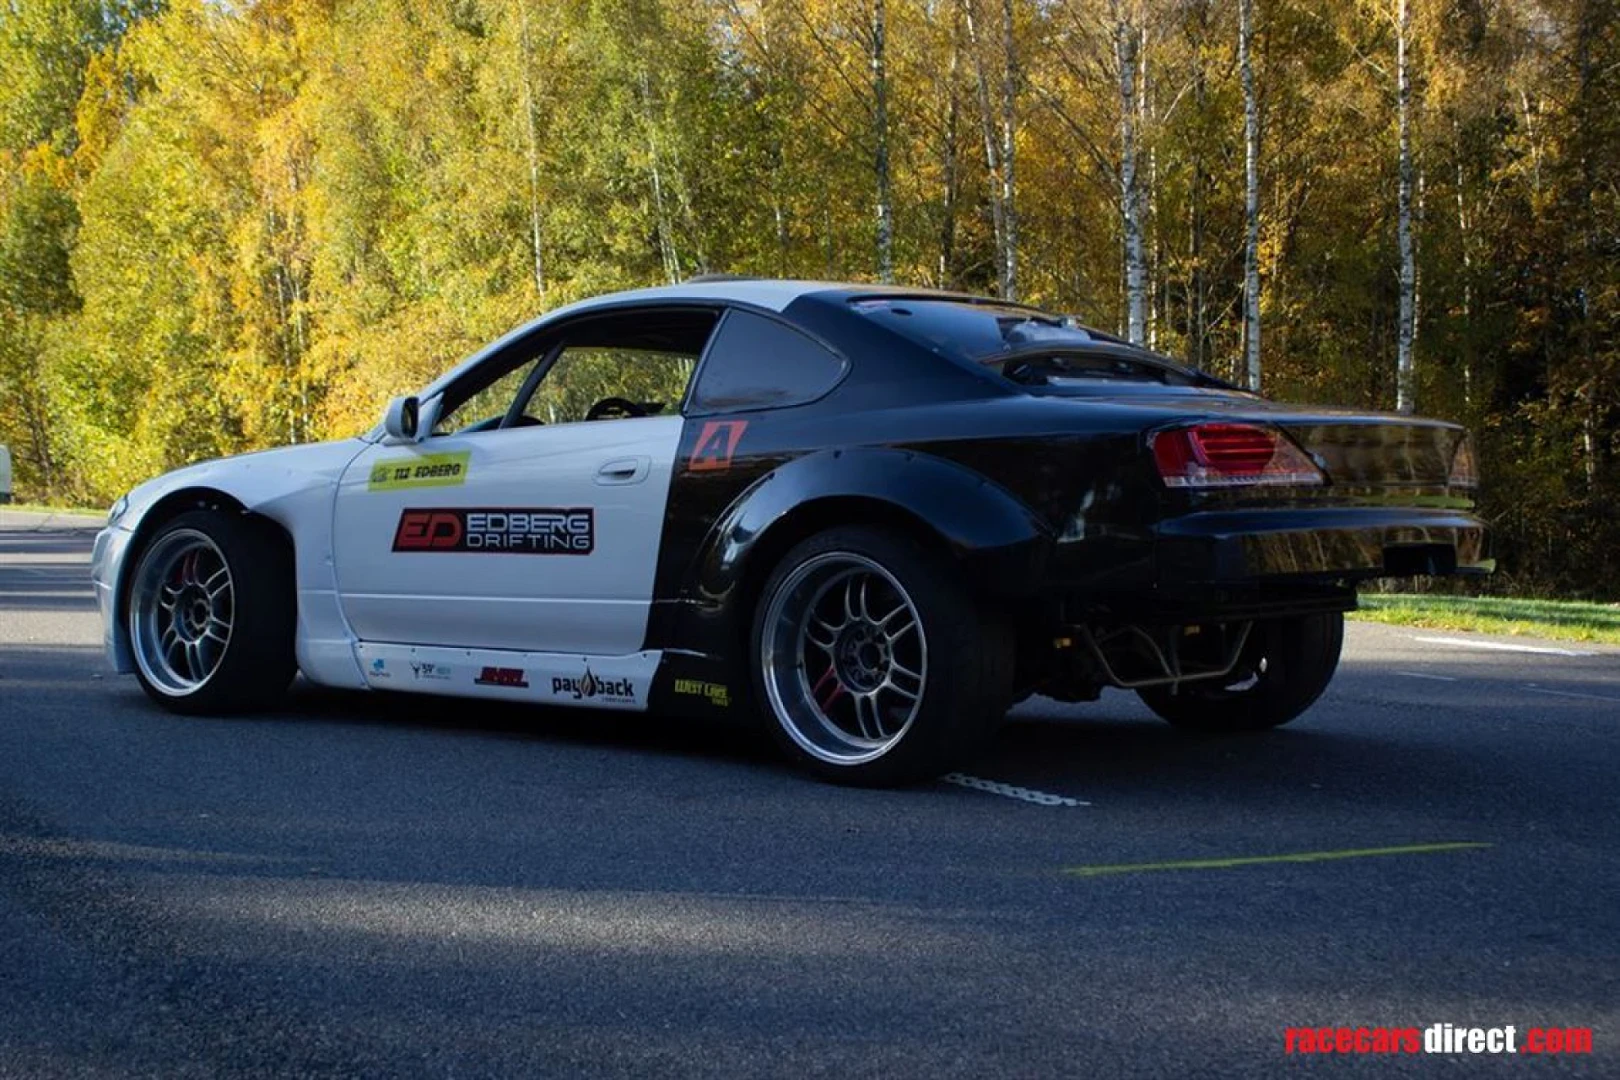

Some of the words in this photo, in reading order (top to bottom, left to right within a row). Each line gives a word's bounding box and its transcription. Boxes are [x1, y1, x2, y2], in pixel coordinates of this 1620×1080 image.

[415, 463, 461, 478] EDBERG
[398, 513, 462, 546] ED
[466, 513, 590, 533] EDBERG
[466, 533, 591, 549] DRIFTING
